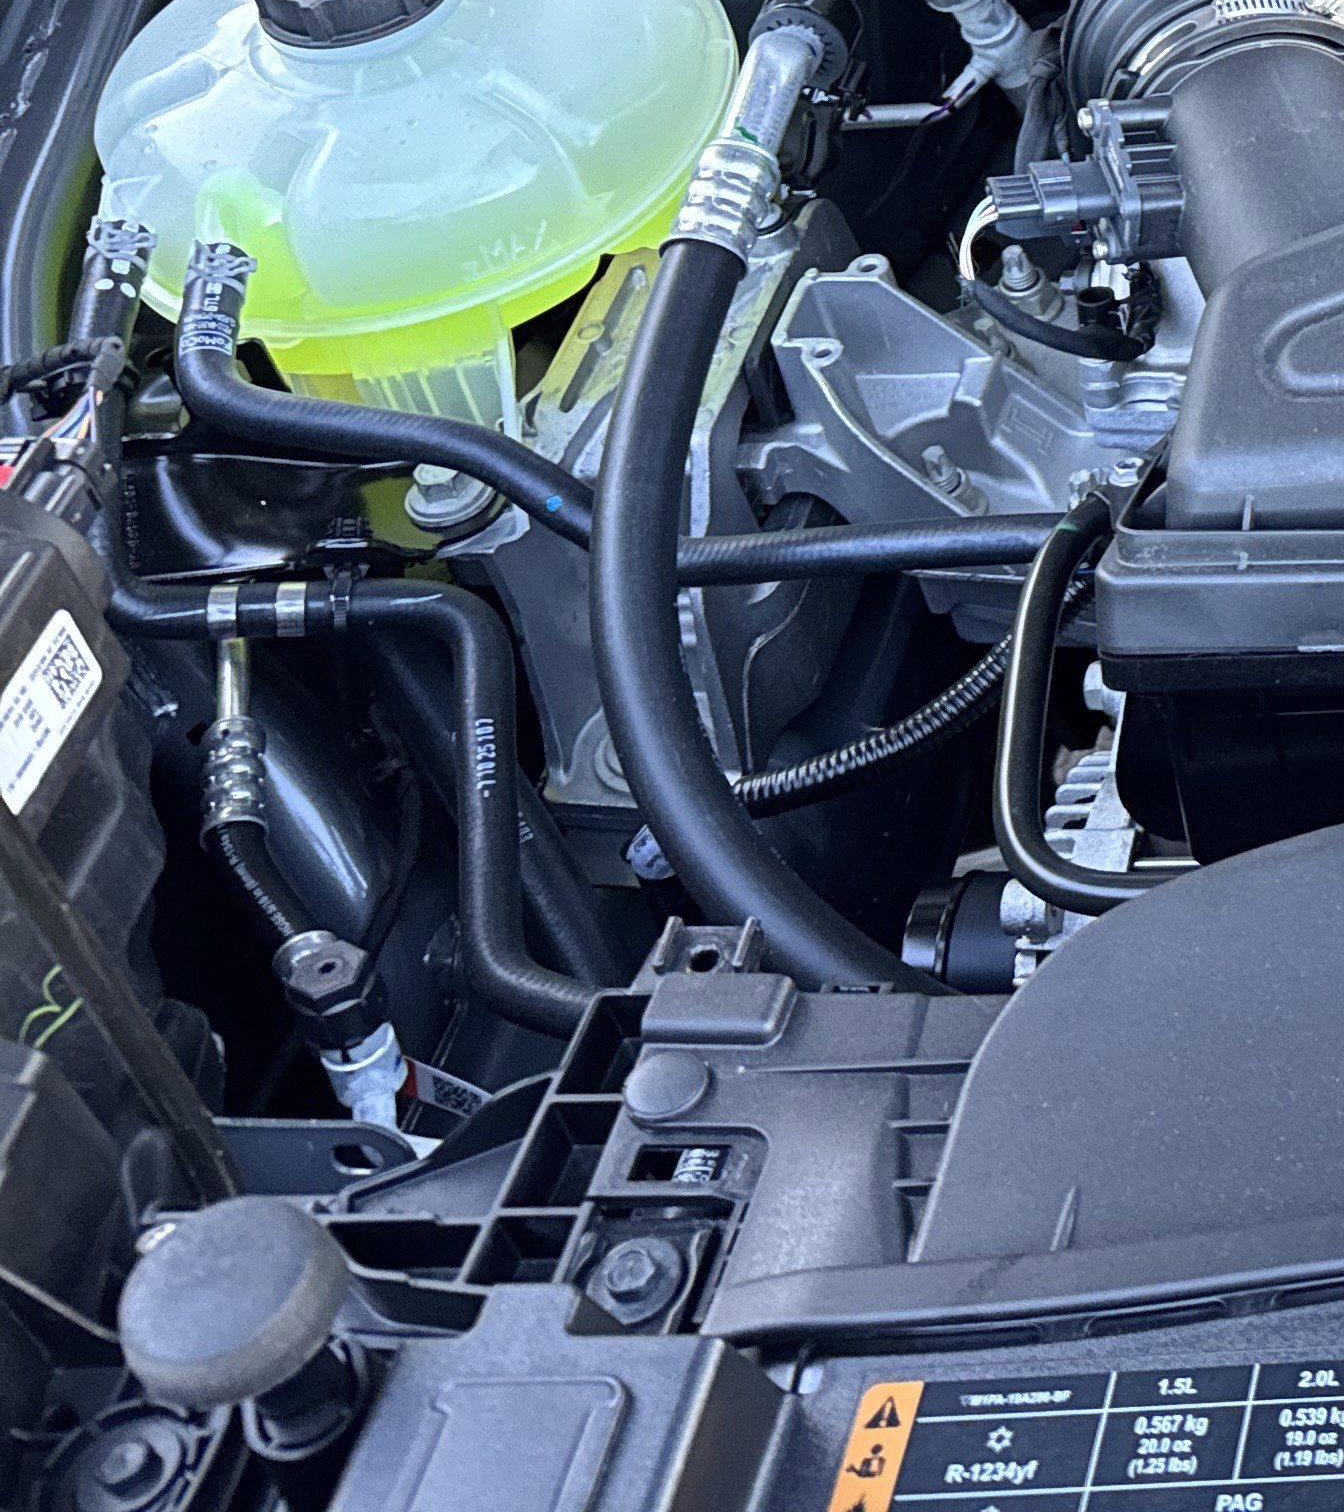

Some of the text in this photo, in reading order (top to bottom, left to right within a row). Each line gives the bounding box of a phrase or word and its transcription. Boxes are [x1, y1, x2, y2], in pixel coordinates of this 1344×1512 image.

[180, 335, 233, 355] FoMoCo
[1158, 1377, 1198, 1395] 1.5L
[1297, 1369, 1340, 1388] 2.0L
[1133, 1414, 1209, 1436] 0.567 kg
[1278, 1407, 1328, 1428] 0.539
[1136, 1437, 1193, 1455] 20.0 oz
[1285, 1430, 1339, 1446] 19.0 oz
[1127, 1455, 1198, 1480] (1.25 lbs)
[1273, 1448, 1344, 1471] (1.19 lbs)
[943, 1459, 1039, 1486] R-1234yf
[1215, 1492, 1264, 1512] PAG
